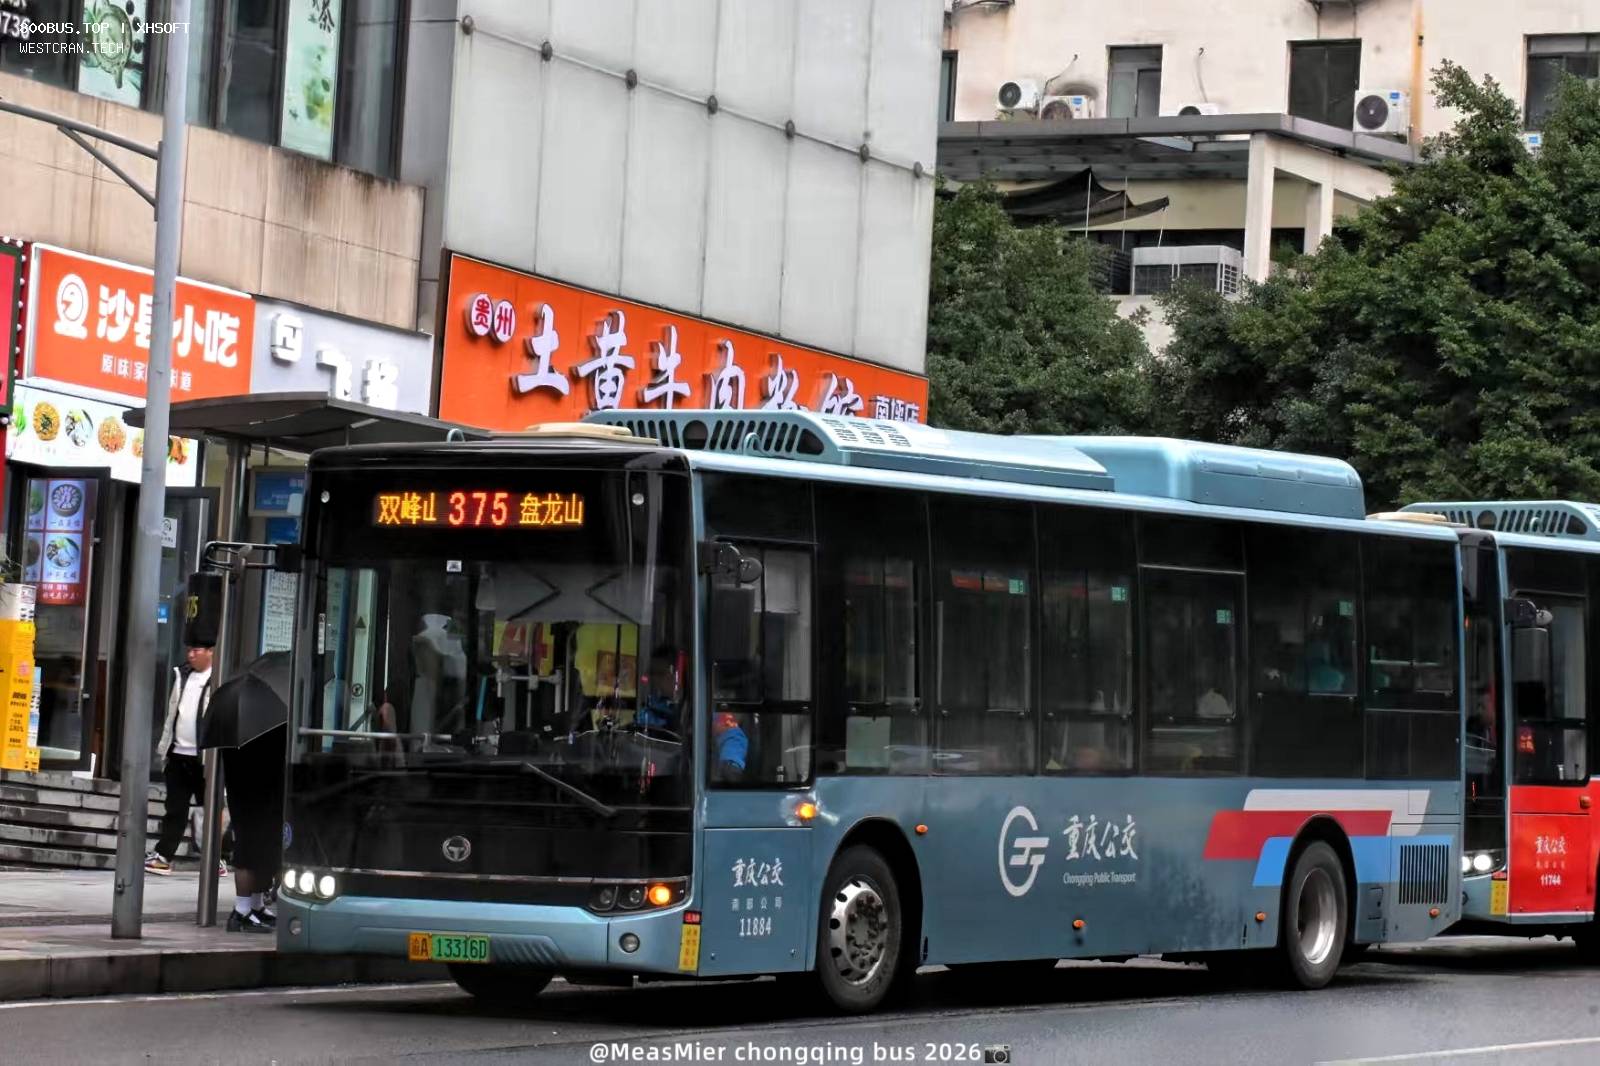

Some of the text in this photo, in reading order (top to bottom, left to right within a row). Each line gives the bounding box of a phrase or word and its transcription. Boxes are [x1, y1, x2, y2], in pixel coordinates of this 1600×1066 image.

[378, 492, 583, 526] 双峰山 375 盘龙山
[1063, 814, 1138, 861] 重庆公交
[731, 857, 784, 888] 重庆公交
[739, 917, 771, 937] 11884
